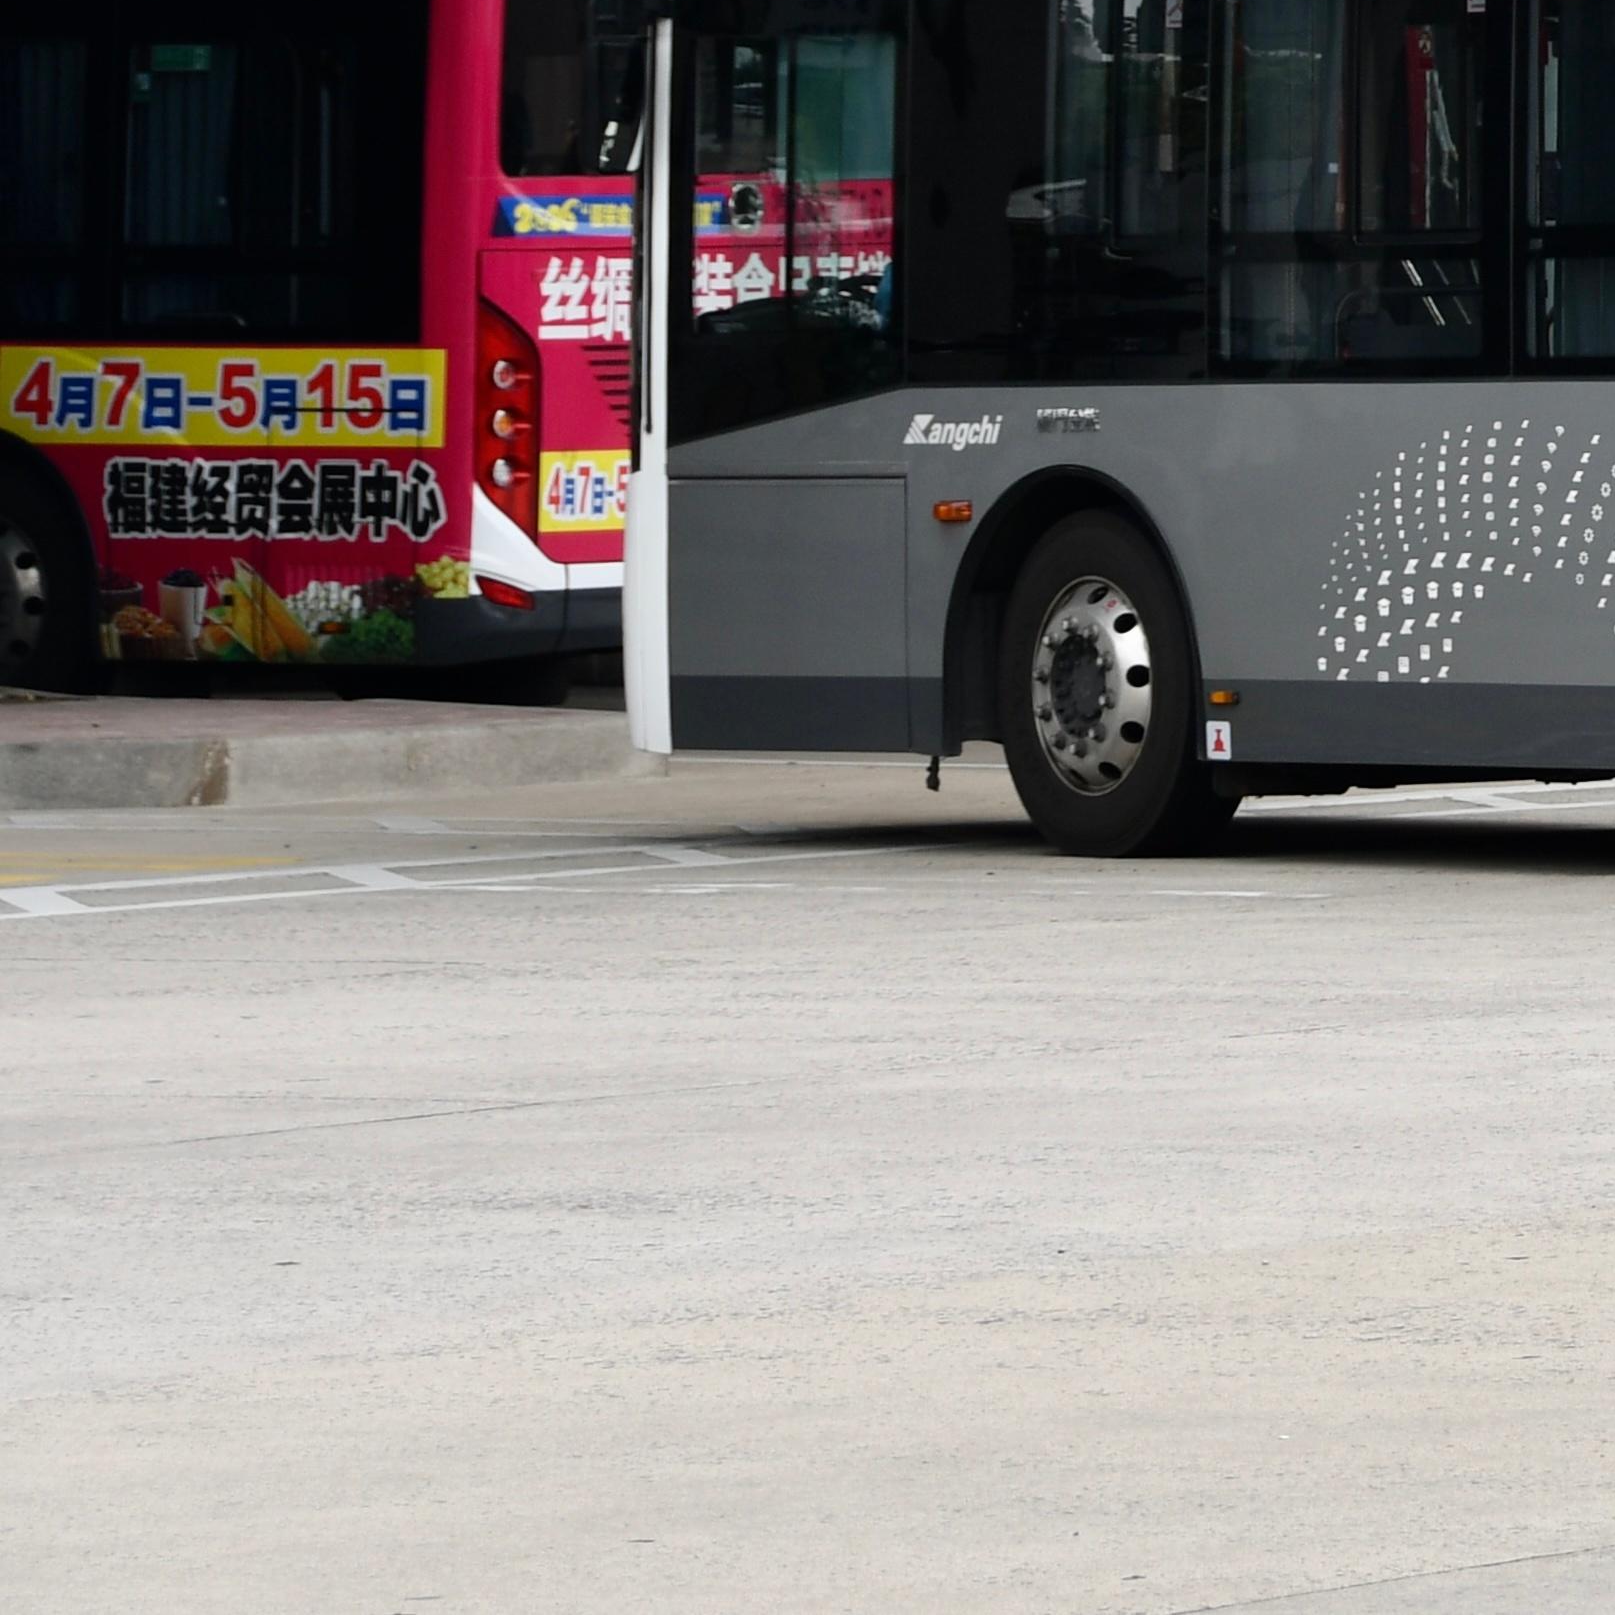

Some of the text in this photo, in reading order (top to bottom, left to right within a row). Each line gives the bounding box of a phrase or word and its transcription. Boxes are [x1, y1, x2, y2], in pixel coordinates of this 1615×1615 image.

[13, 360, 427, 431] 4月7日-5月15日
[104, 456, 446, 542] 福建经贸会展中心
